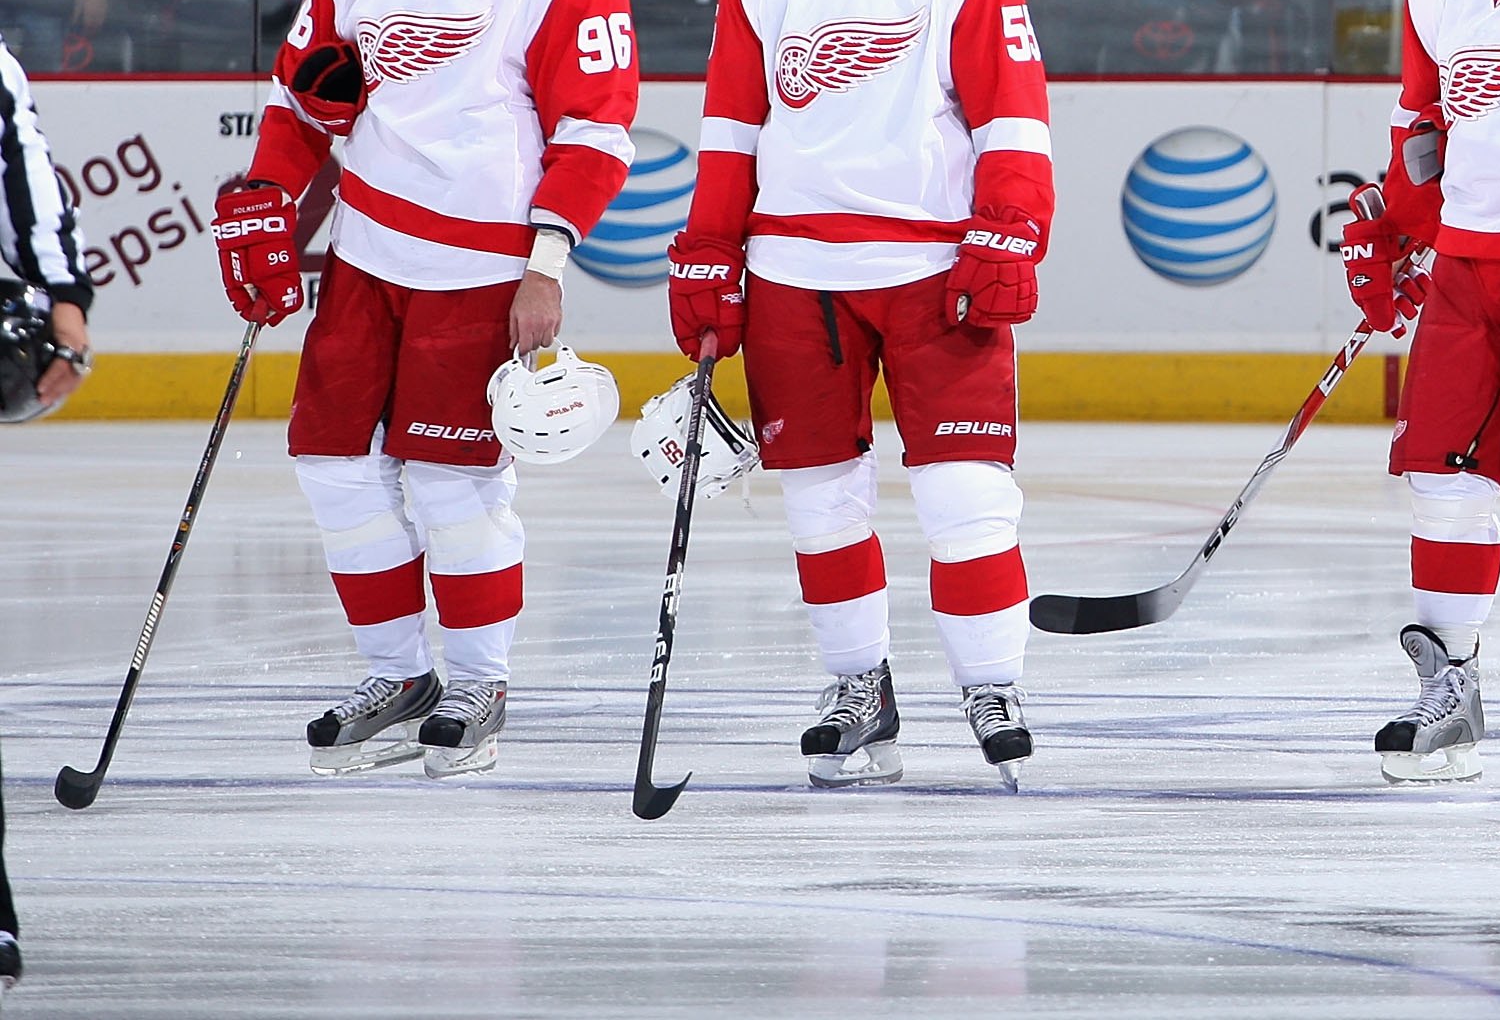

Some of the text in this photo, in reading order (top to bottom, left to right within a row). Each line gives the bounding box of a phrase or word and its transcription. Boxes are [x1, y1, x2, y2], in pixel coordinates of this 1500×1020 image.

[576, 12, 633, 75] 96
[955, 230, 1038, 256] BAUER
[267, 250, 290, 266] 96
[406, 421, 495, 443] BAUER
[935, 421, 1012, 437] BAUER
[660, 439, 684, 465] 55
